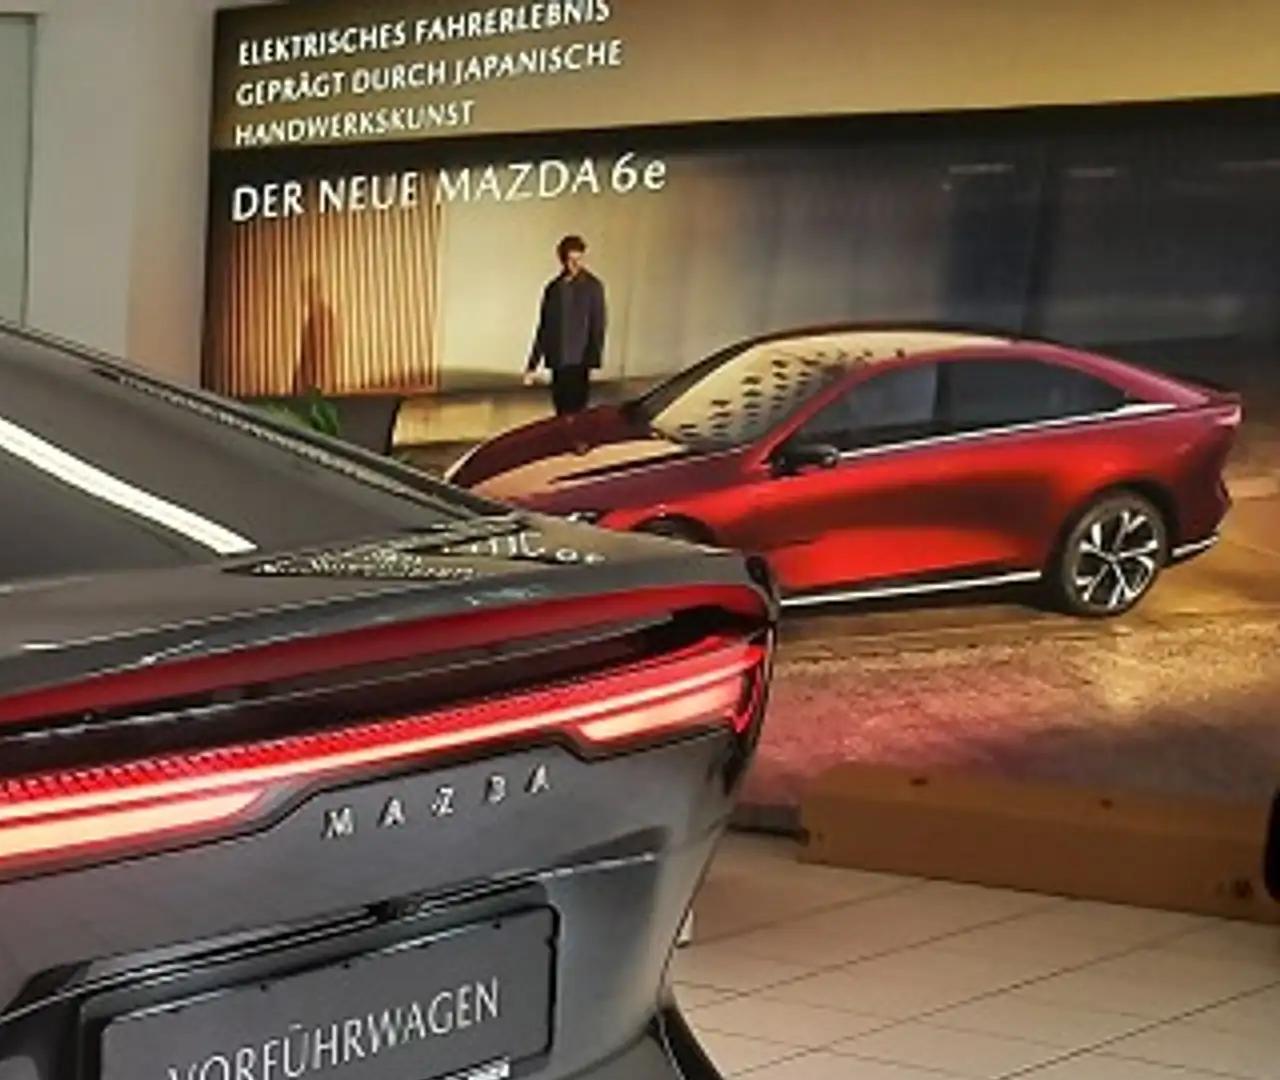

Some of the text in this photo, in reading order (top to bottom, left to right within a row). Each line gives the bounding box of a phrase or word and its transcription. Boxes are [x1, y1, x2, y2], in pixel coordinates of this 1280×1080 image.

[238, 0, 610, 67] ELEKTRISCHES FAHRERLEBNIS
[235, 39, 623, 107] GEPRÄGT DURCH JAPANISCHE
[234, 99, 476, 147] HANDWERKSKUNST
[231, 151, 668, 222] DER NEUE MAZDA 6e
[321, 762, 550, 840] MAZDA
